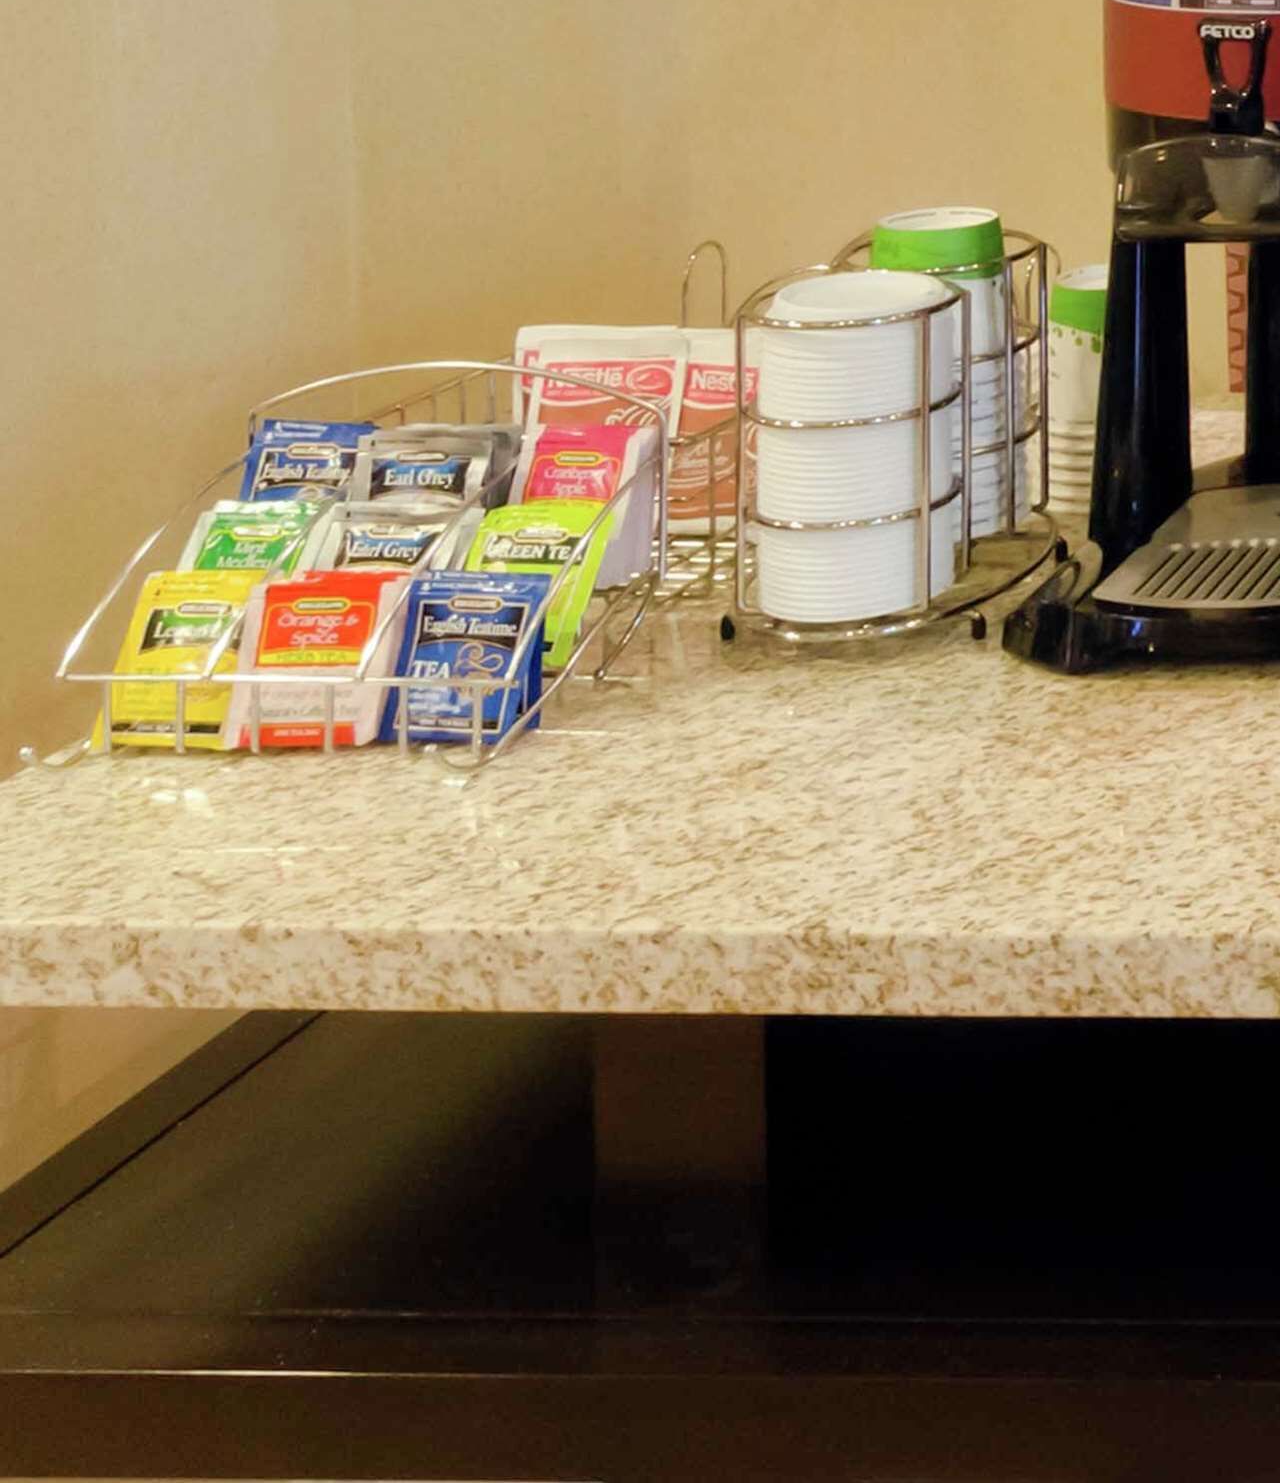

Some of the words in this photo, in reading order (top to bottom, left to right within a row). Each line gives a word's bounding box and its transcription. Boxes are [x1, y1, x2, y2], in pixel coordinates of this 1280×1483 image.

[1200, 24, 1255, 39] FETCO
[384, 468, 415, 486] Earl
[417, 468, 455, 490] Grey
[350, 542, 383, 558] Earl
[384, 541, 421, 563] Grey
[487, 535, 545, 559] GREEN
[278, 611, 343, 631] Orange
[424, 614, 467, 637] English
[469, 618, 518, 637] Teatime
[288, 630, 339, 648] Spice
[412, 660, 449, 678] TEA
